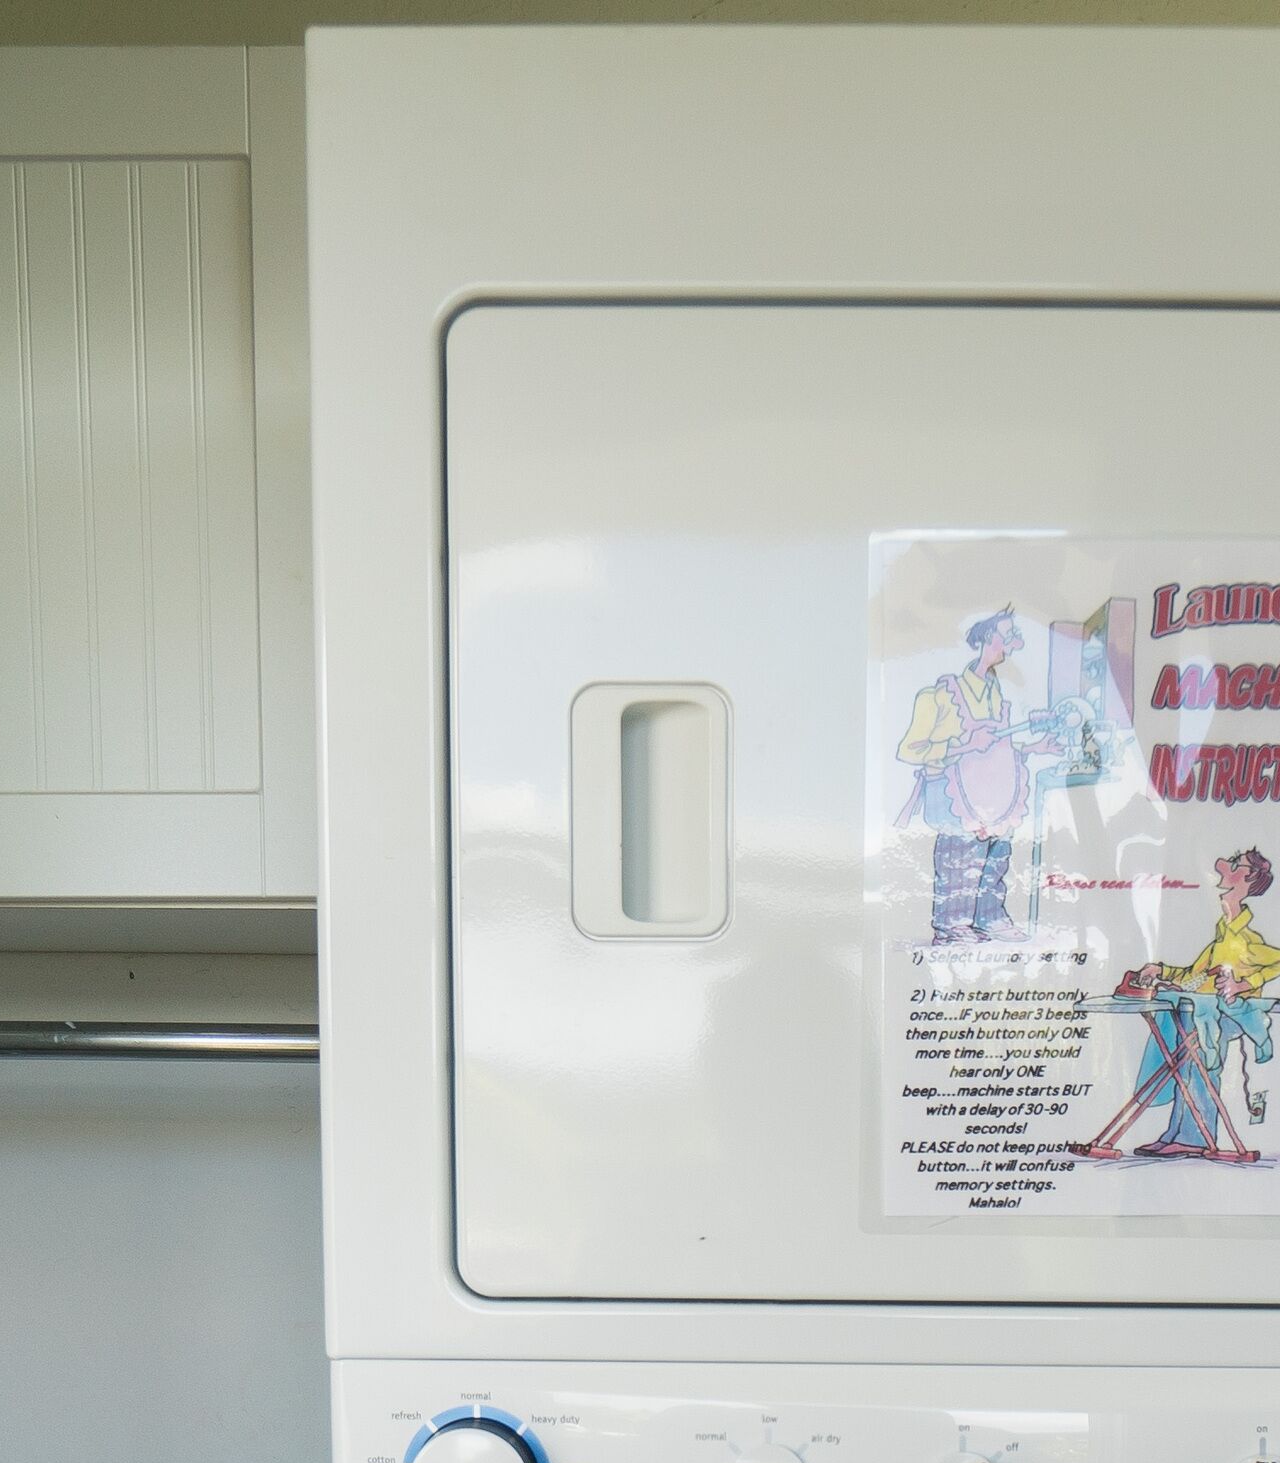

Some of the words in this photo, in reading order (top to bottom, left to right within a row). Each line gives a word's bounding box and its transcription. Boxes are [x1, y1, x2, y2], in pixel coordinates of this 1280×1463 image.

[928, 951, 973, 967] Select
[1037, 952, 1087, 966] setting
[910, 990, 926, 1004] 2)
[930, 989, 965, 1001] Push
[967, 990, 1003, 1001] start
[1005, 989, 1055, 1001] button
[1057, 989, 1088, 1004] only
[972, 1011, 1000, 1023] you
[1002, 1009, 1033, 1021] hear
[1034, 1009, 1044, 1020] 3
[1045, 1009, 1088, 1023] beeps
[906, 1028, 937, 1040] then
[939, 1028, 974, 1042] push
[976, 1028, 1026, 1040] button
[1027, 1027, 1059, 1042] only
[1061, 1026, 1091, 1039] ONE
[915, 1049, 951, 1059] more
[1034, 1046, 1081, 1059] should
[949, 1066, 981, 1078] hear
[983, 1065, 1014, 1080] only
[1016, 1065, 1046, 1077] ONE
[1016, 1085, 1060, 1097] starts
[1062, 1084, 1093, 1096] BUT
[926, 1104, 957, 1116] with
[959, 1106, 967, 1116] a
[969, 1103, 1006, 1118] delay
[1008, 1103, 1024, 1115] of
[1025, 1103, 1068, 1115] 30-90
[965, 1122, 1028, 1135] seconds!
[901, 1141, 956, 1153] PLEASE
[956, 1141, 973, 1153] do
[976, 1142, 1000, 1153] not
[1002, 1141, 1035, 1155] keep
[1038, 1141, 1092, 1155] pushing
[995, 1160, 1017, 1172] will
[1019, 1160, 1075, 1172] confuse
[935, 1181, 993, 1193] memory
[995, 1180, 1056, 1193] settings.
[968, 1197, 1022, 1209] Mahalo!
[460, 1391, 491, 1401] normal
[391, 1411, 422, 1421] refresh
[531, 1414, 557, 1425] heavy
[559, 1414, 580, 1425] duty
[762, 1414, 778, 1424] low
[958, 1424, 970, 1432] on
[1256, 1425, 1268, 1433] on
[695, 1432, 727, 1441] normal
[811, 1434, 824, 1443] air
[826, 1434, 841, 1445] dry
[1006, 1442, 1019, 1452] off
